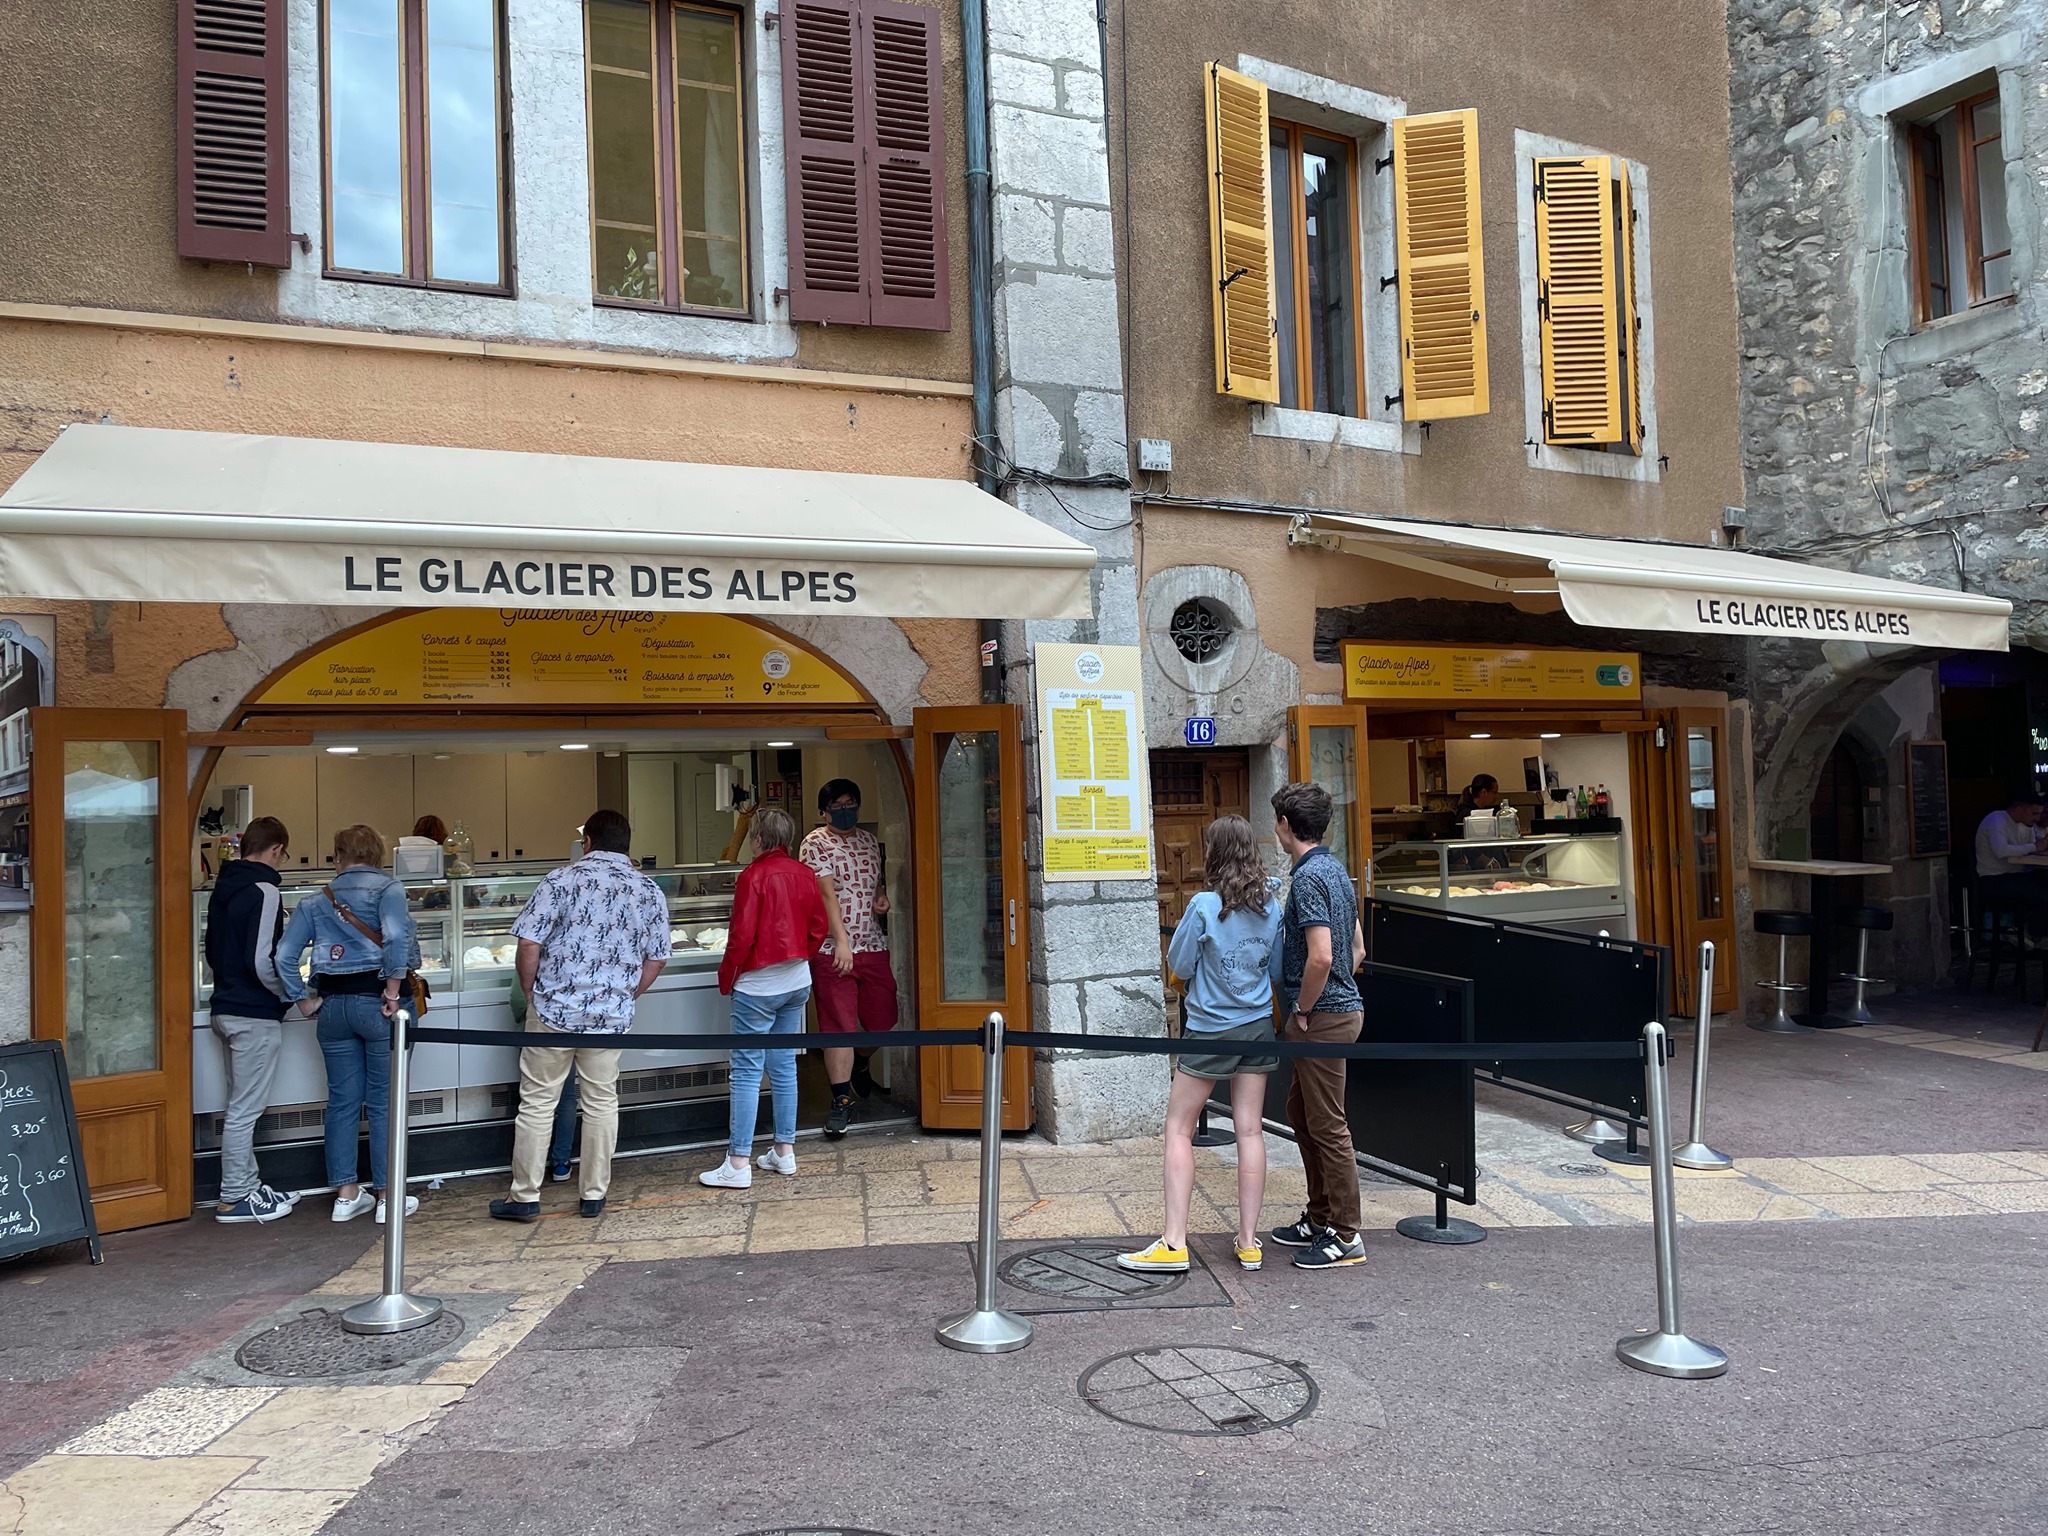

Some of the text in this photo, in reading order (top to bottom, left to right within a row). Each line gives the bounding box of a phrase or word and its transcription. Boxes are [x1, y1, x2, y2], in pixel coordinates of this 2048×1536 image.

[345, 555, 857, 602] LE GLACIER DES ALPES
[1697, 599, 1910, 636] LE GLACIER DES ALPES
[422, 633, 507, 648] Cornets & coupes
[642, 637, 695, 651] Dégustation
[531, 651, 616, 665] Glaces à emporter
[328, 664, 376, 674] Fabrication
[1358, 656, 1430, 678] Glacier des Alpes
[349, 676, 372, 686] place
[642, 670, 734, 683] Boissons à emporter
[307, 688, 332, 699] depuis
[335, 688, 353, 698] plus
[368, 687, 380, 696] 50
[1192, 722, 1210, 740] 16
[1322, 1244, 1344, 1261] N
